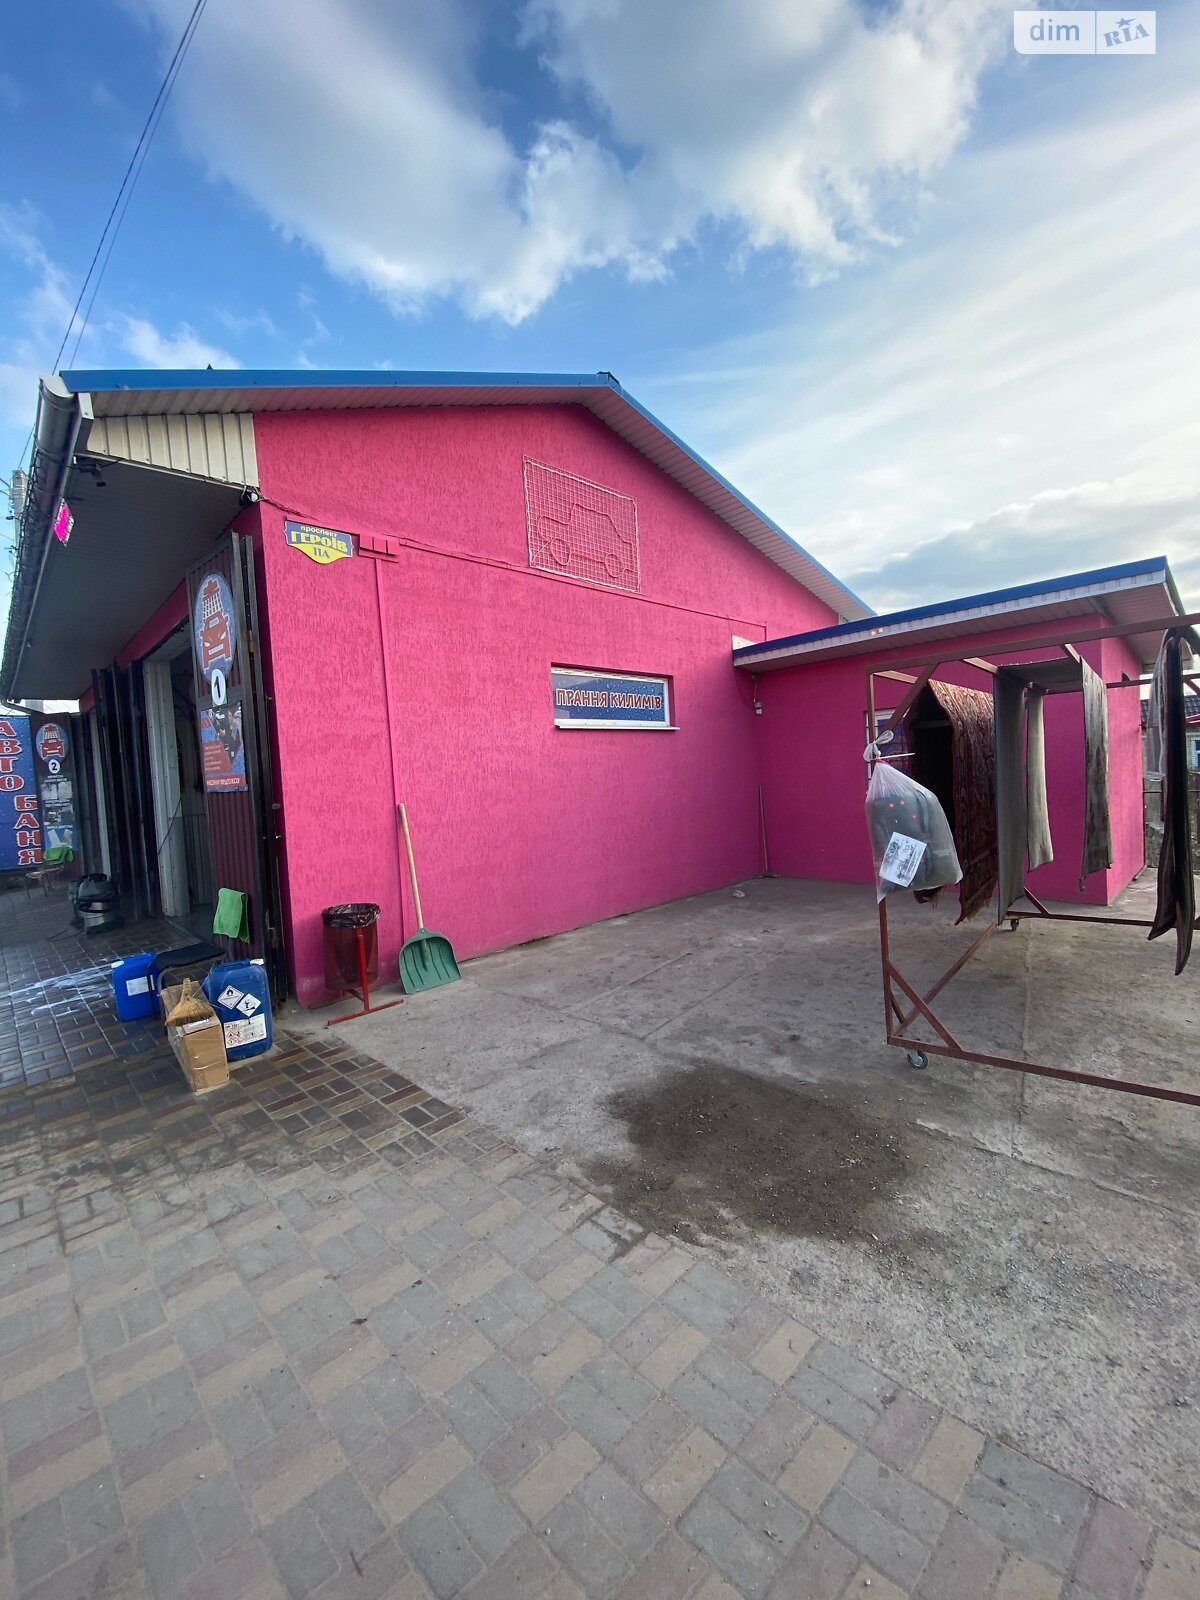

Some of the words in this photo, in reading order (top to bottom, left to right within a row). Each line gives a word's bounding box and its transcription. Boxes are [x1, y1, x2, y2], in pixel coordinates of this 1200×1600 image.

[300, 525, 338, 538] проспект
[213, 675, 221, 698] 1
[556, 688, 608, 708] ПРАННЯ
[609, 691, 662, 710] КИЛИМІВ
[0, 720, 25, 792] АВТО
[51, 761, 58, 772] 2
[13, 794, 43, 866] БАНЯ
